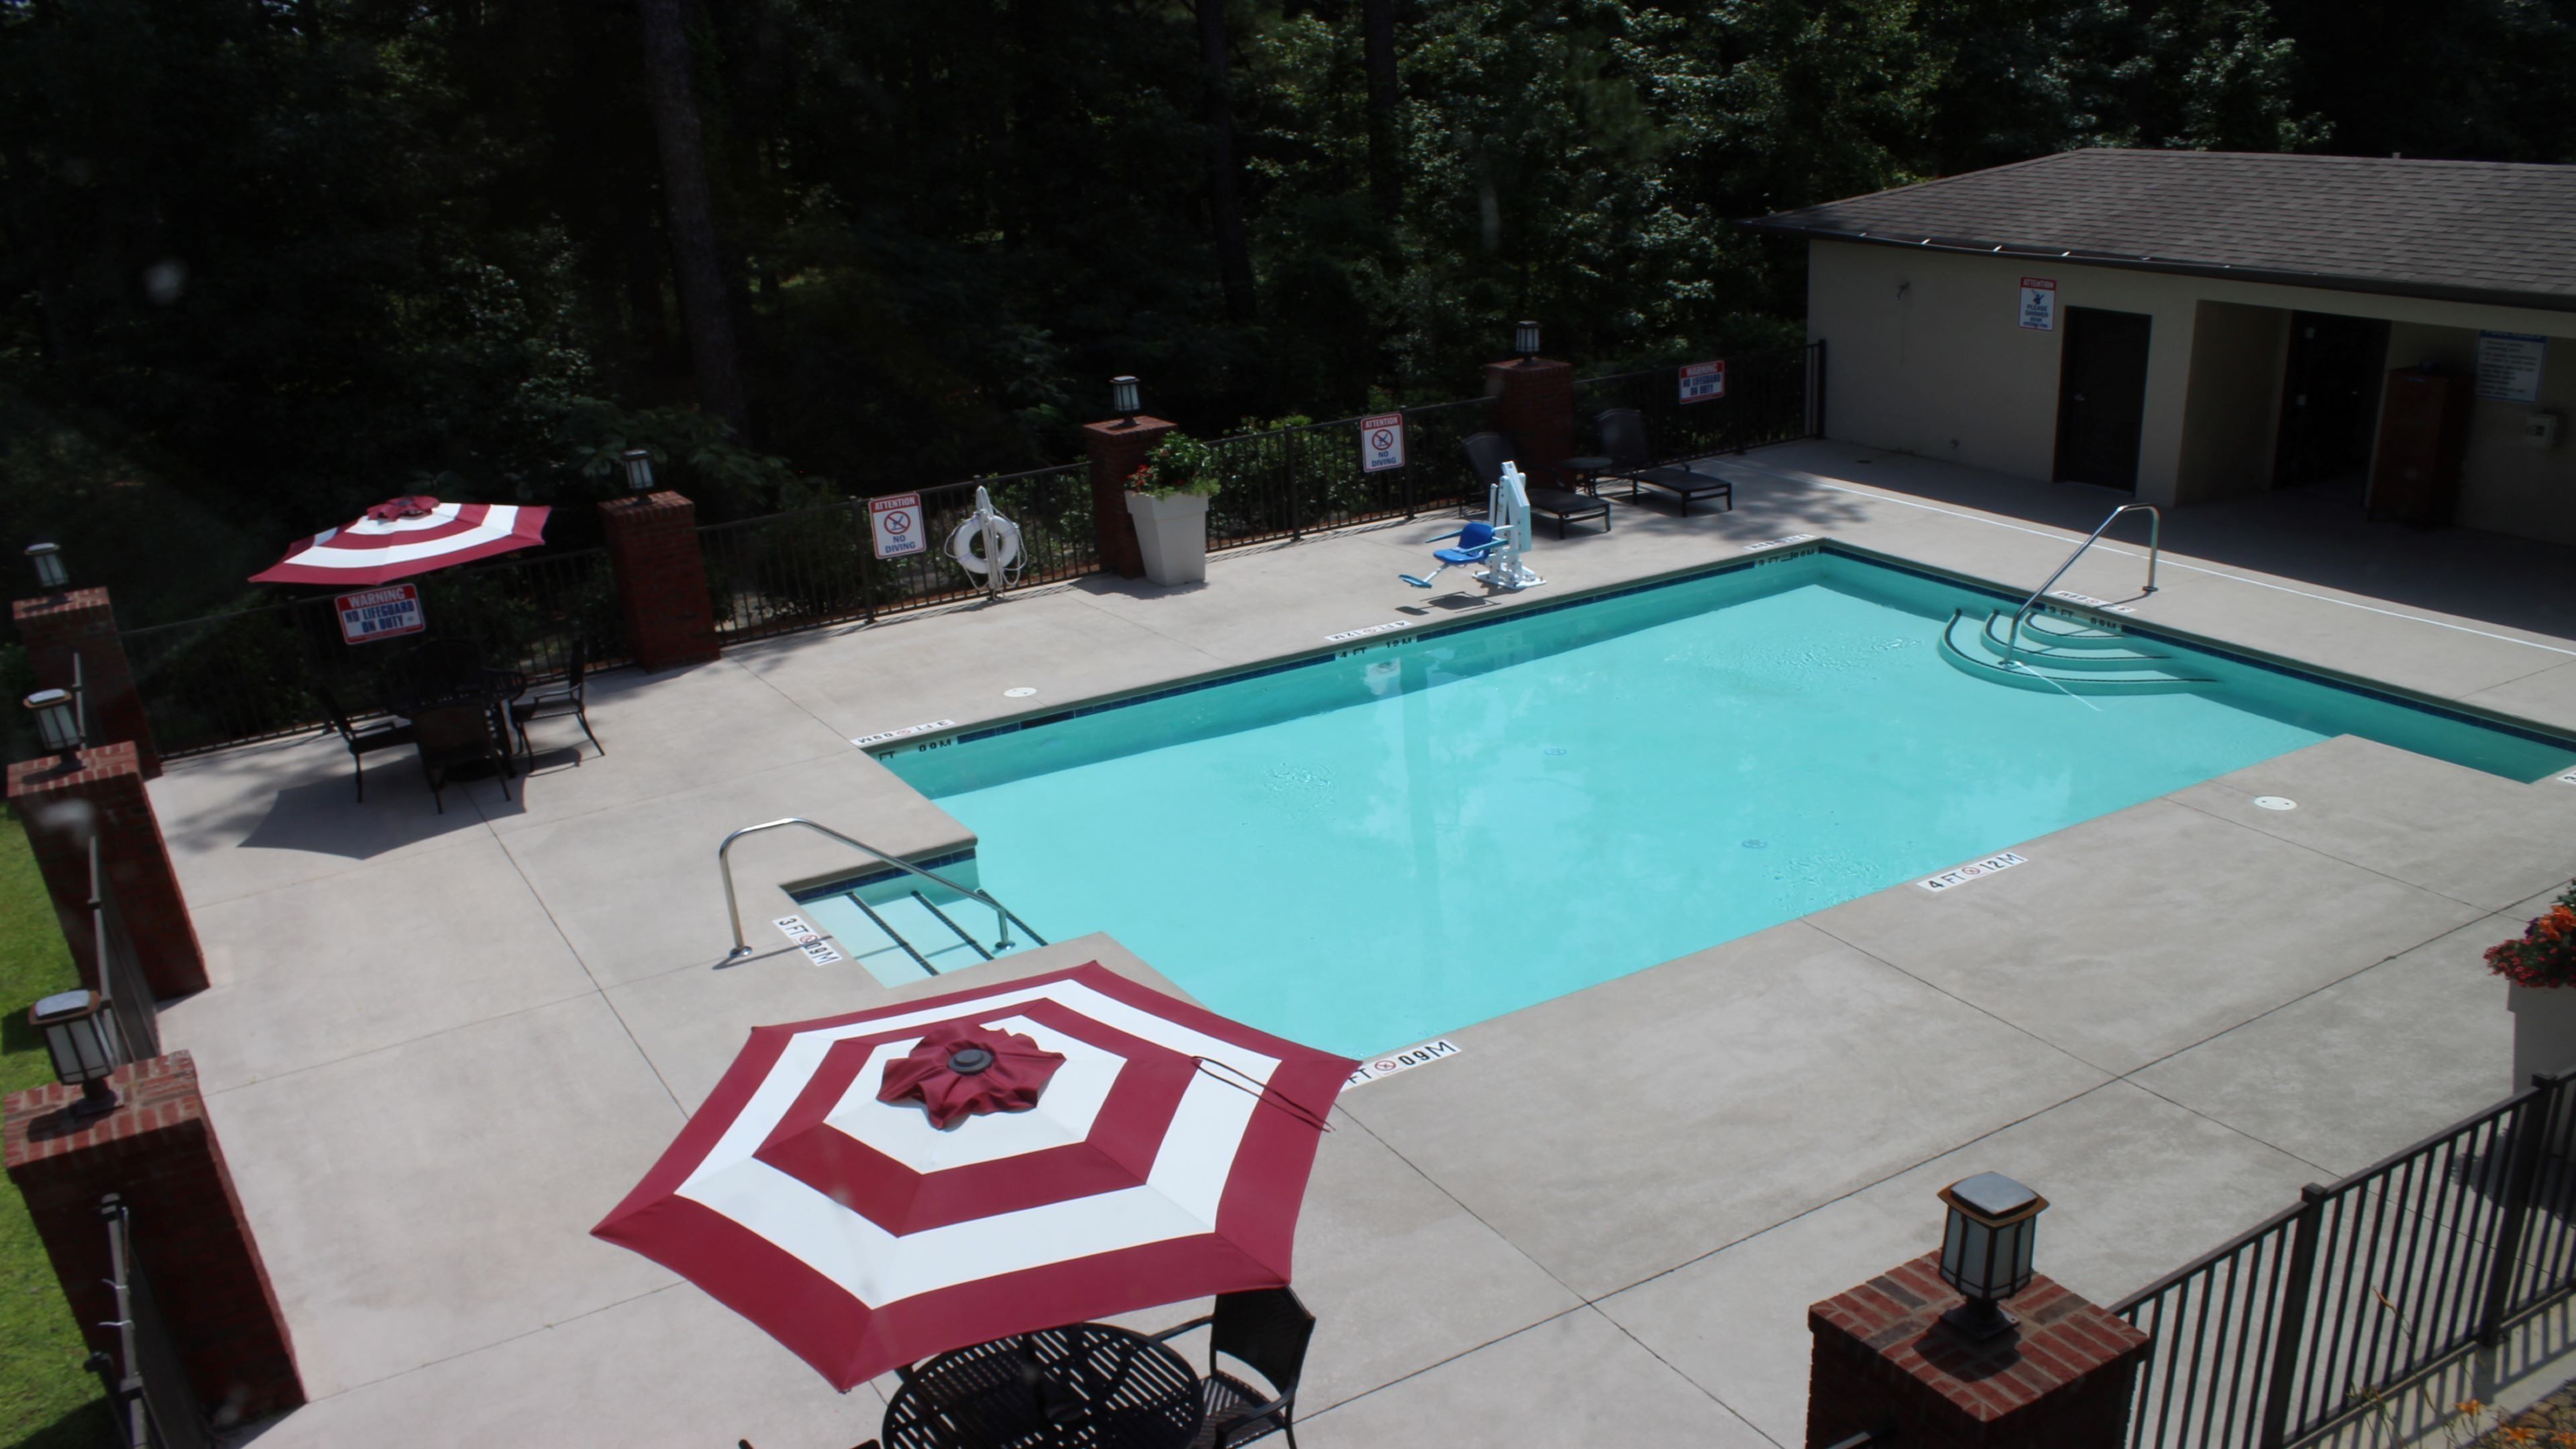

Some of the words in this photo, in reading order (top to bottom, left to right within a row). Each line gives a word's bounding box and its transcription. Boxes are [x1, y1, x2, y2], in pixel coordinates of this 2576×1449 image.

[1365, 417, 1398, 429] ATTENTION
[1372, 457, 1397, 467] DIVING
[875, 496, 916, 511] ATTENTION
[893, 535, 906, 543] NO
[885, 541, 916, 553] DIVING
[347, 587, 405, 608] WARNING
[345, 610, 360, 623] NO
[362, 600, 415, 621] LIFEGUARD
[361, 621, 376, 633] ON
[378, 614, 403, 629] DUTY
[879, 750, 896, 761] FT
[1928, 879, 1945, 889] 4
[1941, 872, 1966, 884] FT
[1979, 853, 2025, 871] 12M
[779, 918, 798, 926] 3
[785, 924, 809, 936] FT
[1398, 1041, 1457, 1066] 09M
